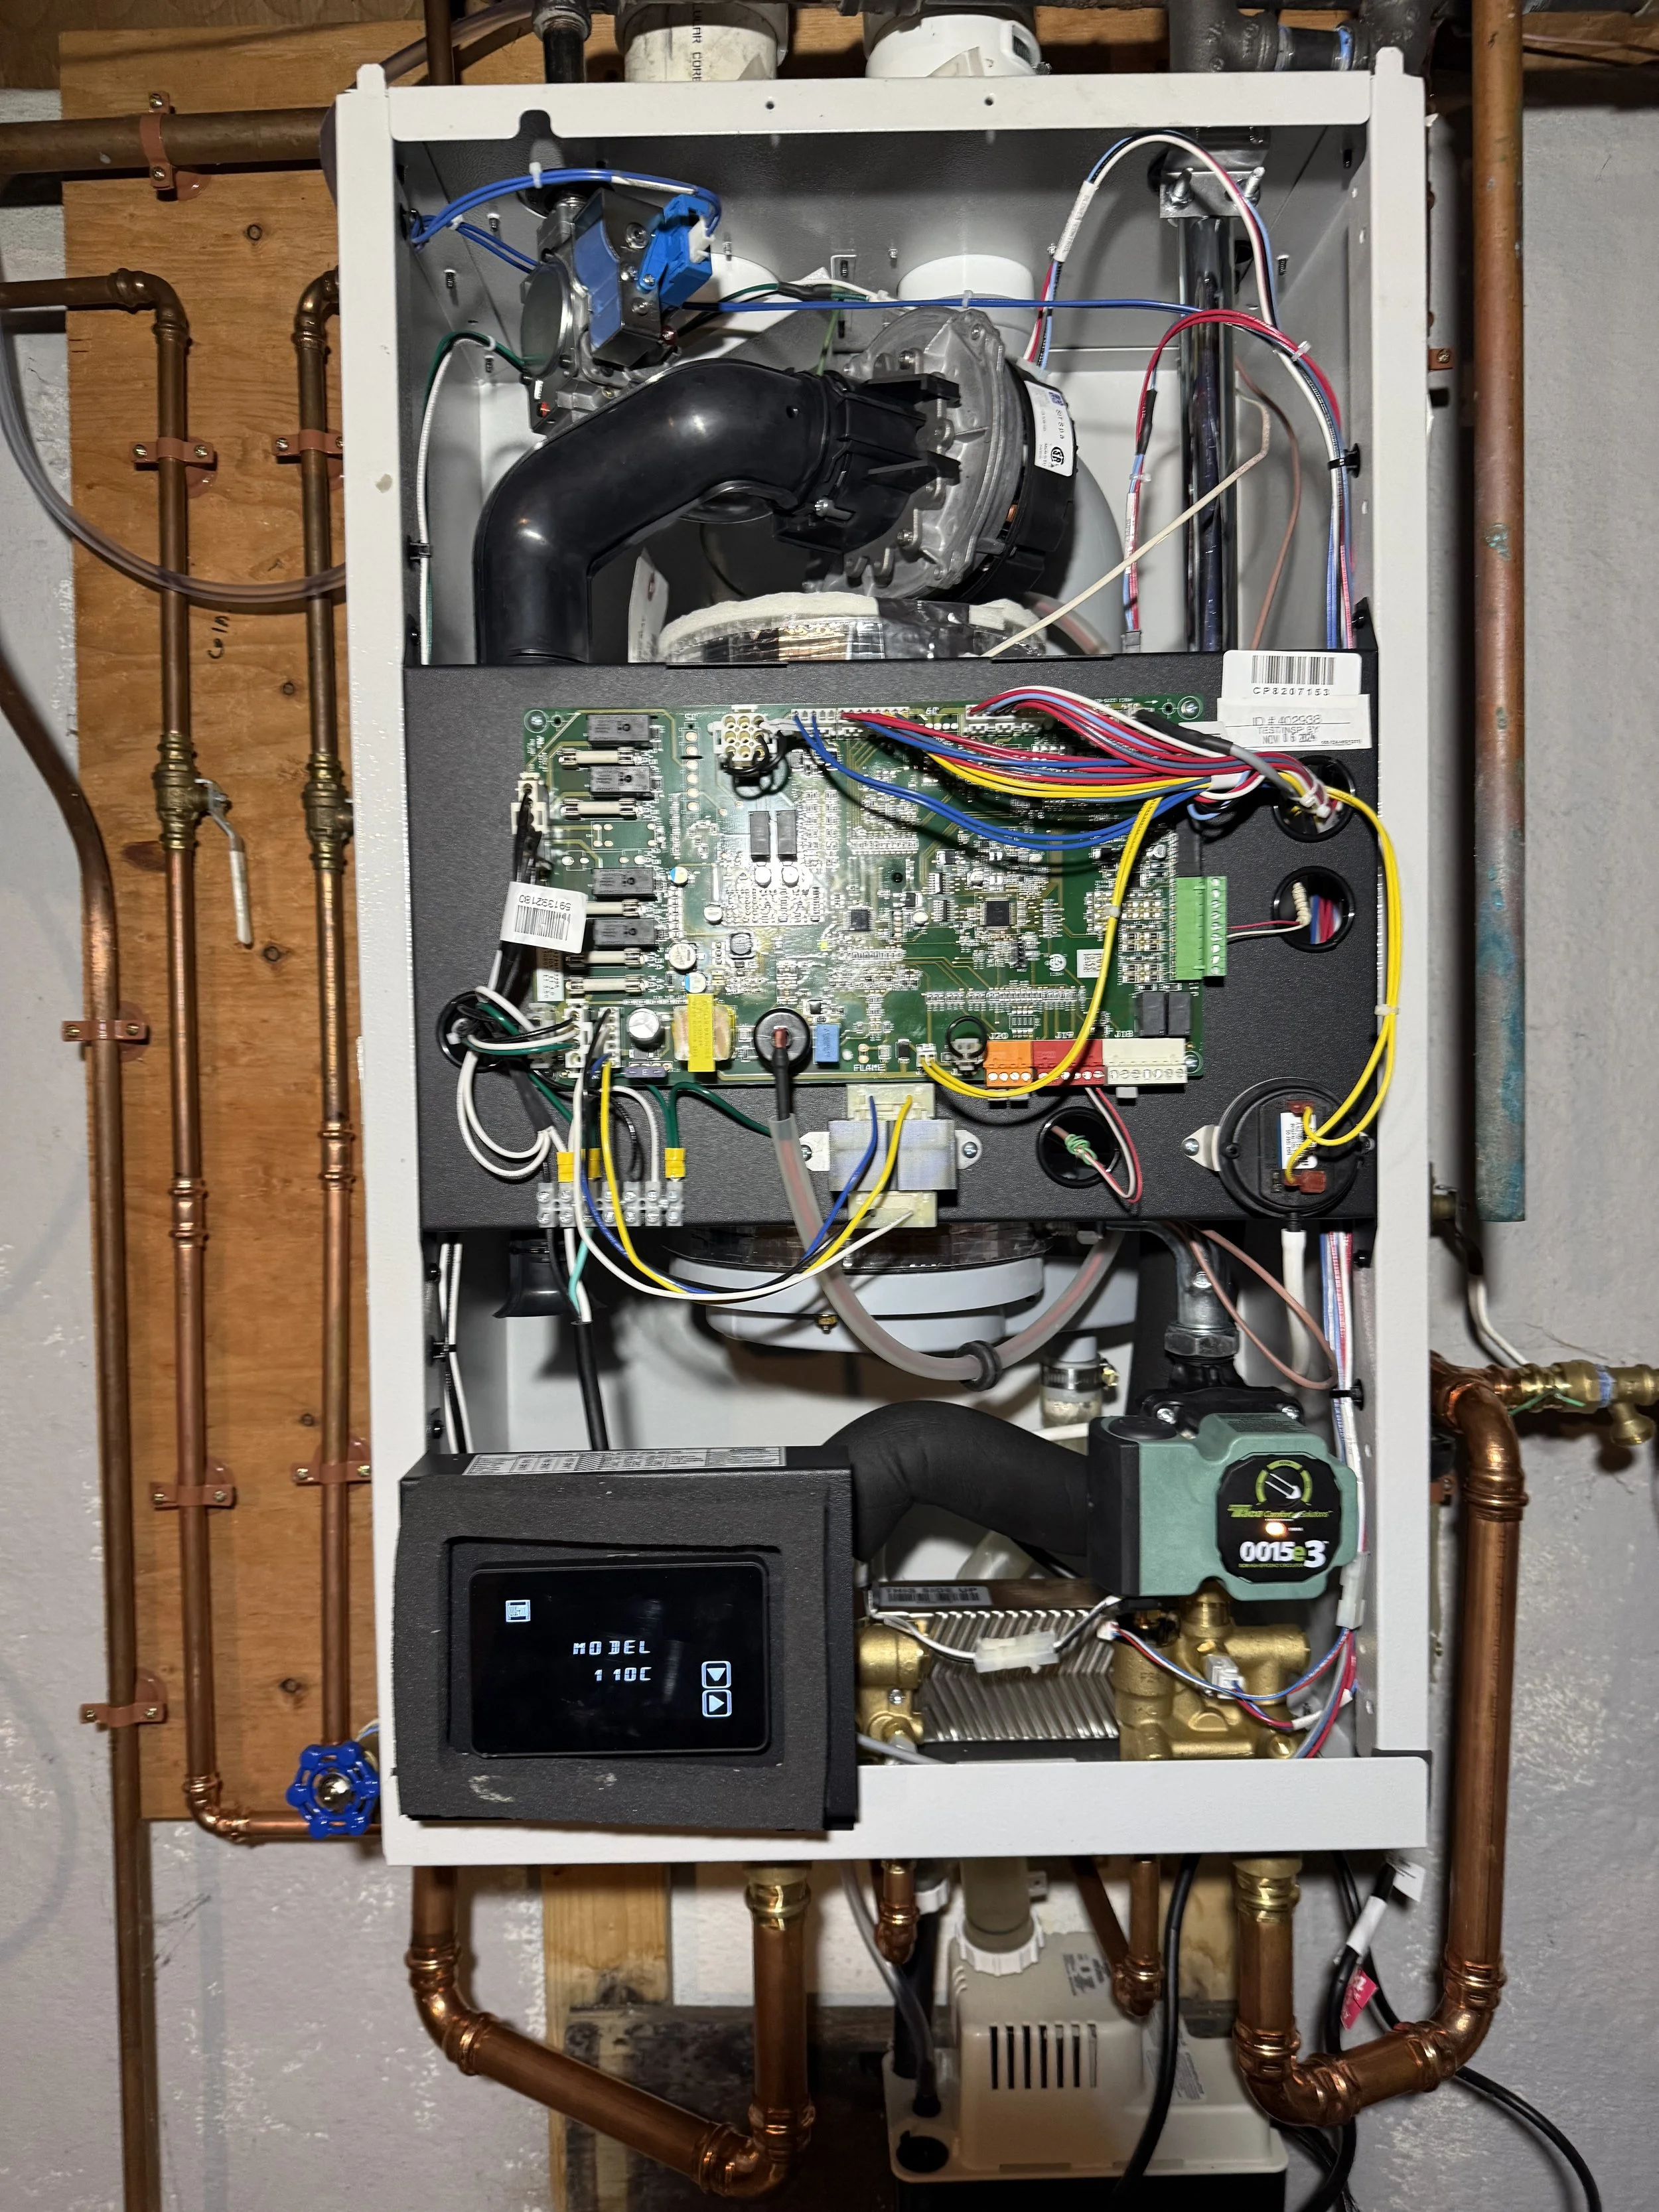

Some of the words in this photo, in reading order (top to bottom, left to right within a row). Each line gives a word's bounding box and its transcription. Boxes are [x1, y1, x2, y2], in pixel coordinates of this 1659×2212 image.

[1252, 686, 1331, 696] CP8207153
[1239, 1539, 1327, 1569] 0015e3
[573, 1640, 651, 1655] MODEL
[595, 1666, 652, 1682] 110C
